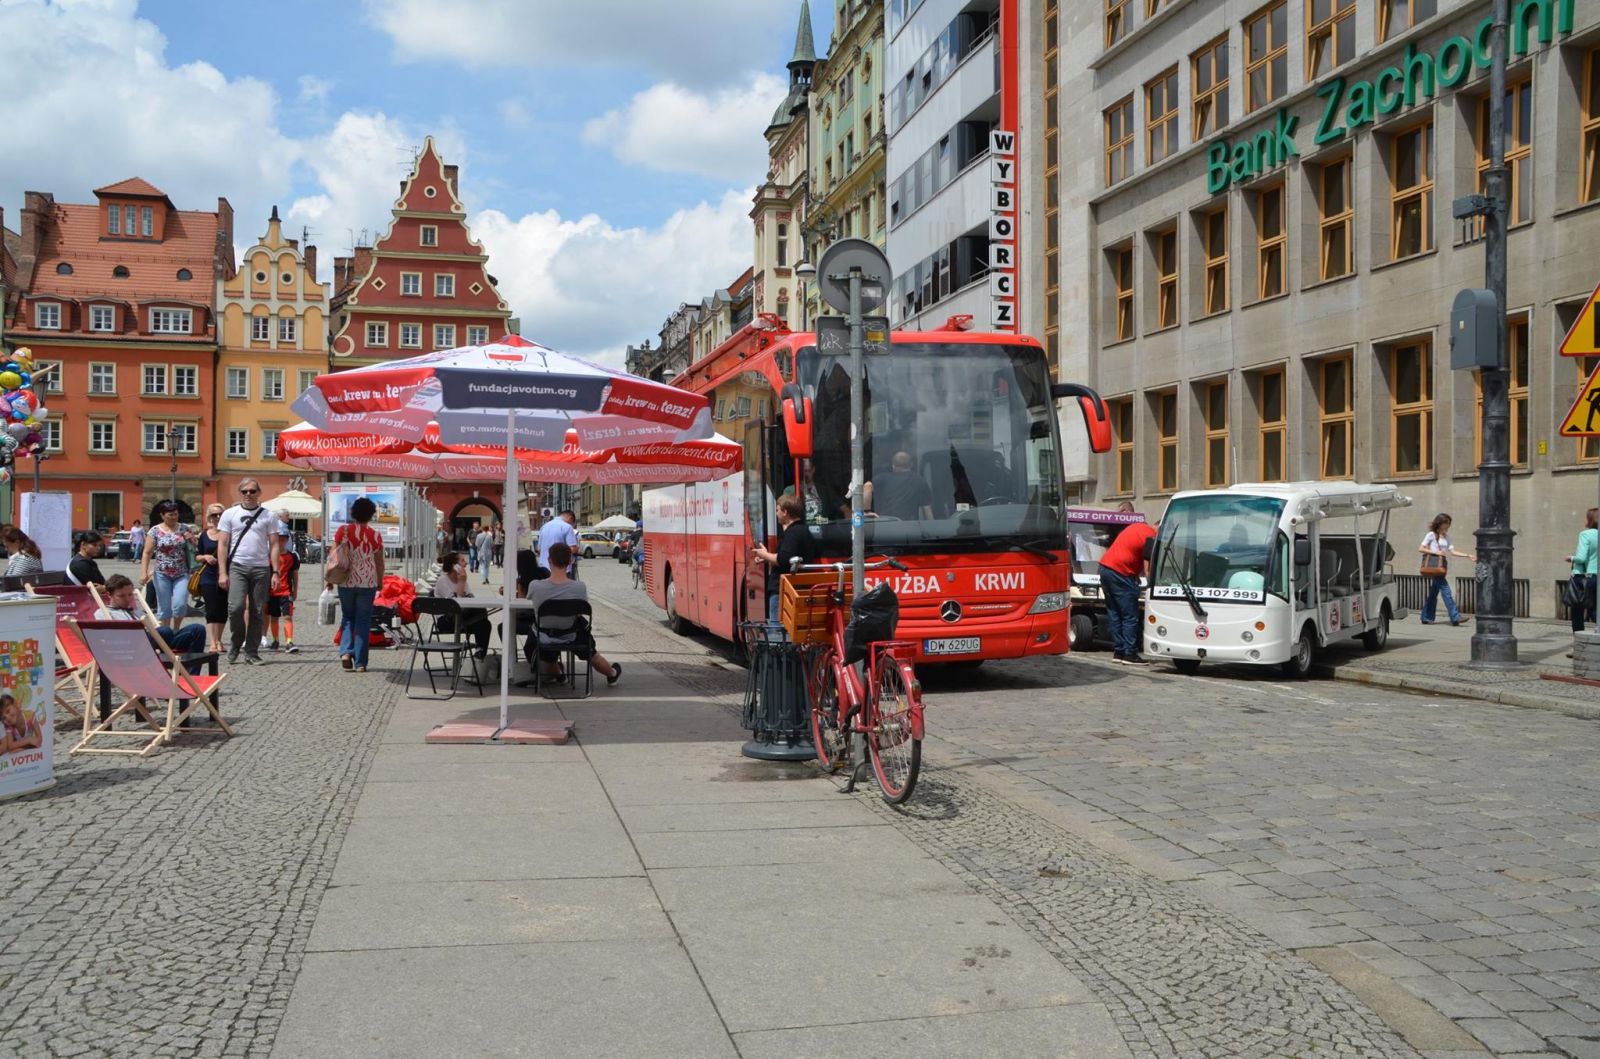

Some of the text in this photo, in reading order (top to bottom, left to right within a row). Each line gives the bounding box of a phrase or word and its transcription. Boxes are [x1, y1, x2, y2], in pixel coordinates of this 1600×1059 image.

[1206, 106, 1300, 195] Bank
[343, 389, 371, 401] krew
[468, 383, 577, 398] fundacjavotum.org
[624, 394, 649, 408] krew
[647, 401, 657, 411] tu
[660, 400, 696, 419] teraz!
[1066, 511, 1090, 519] BEST
[1114, 514, 1145, 522] TOURS
[975, 572, 1025, 591] KRWI
[1157, 587, 1178, 595] +48
[1208, 589, 1229, 597] 107
[1233, 590, 1258, 599] 999
[930, 639, 979, 651] DW 629UG
[11, 751, 44, 767] VOTUM
